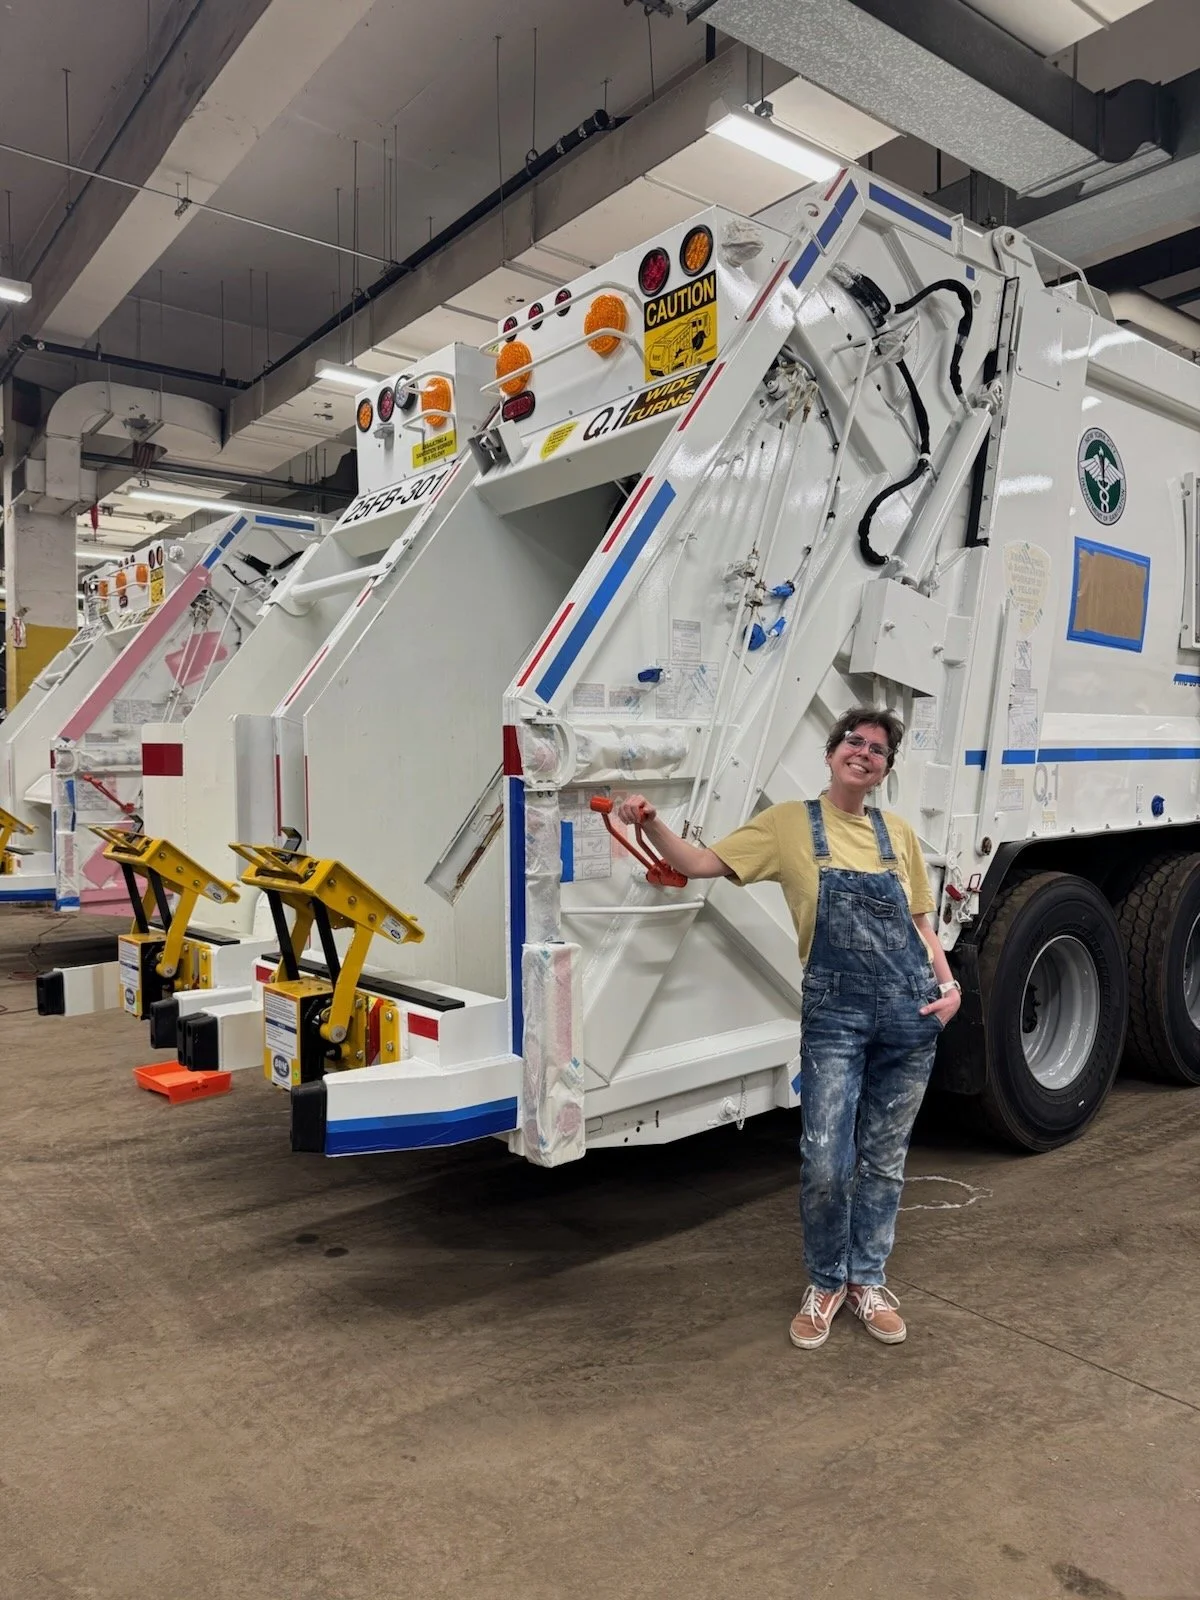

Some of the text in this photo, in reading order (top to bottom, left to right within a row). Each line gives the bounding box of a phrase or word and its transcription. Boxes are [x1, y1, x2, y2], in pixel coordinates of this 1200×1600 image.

[646, 275, 715, 326] CAUTION
[627, 389, 695, 424] TURNS
[645, 371, 701, 403] WIDE
[583, 399, 634, 441] Q.1
[342, 470, 449, 524] 25FB-301
